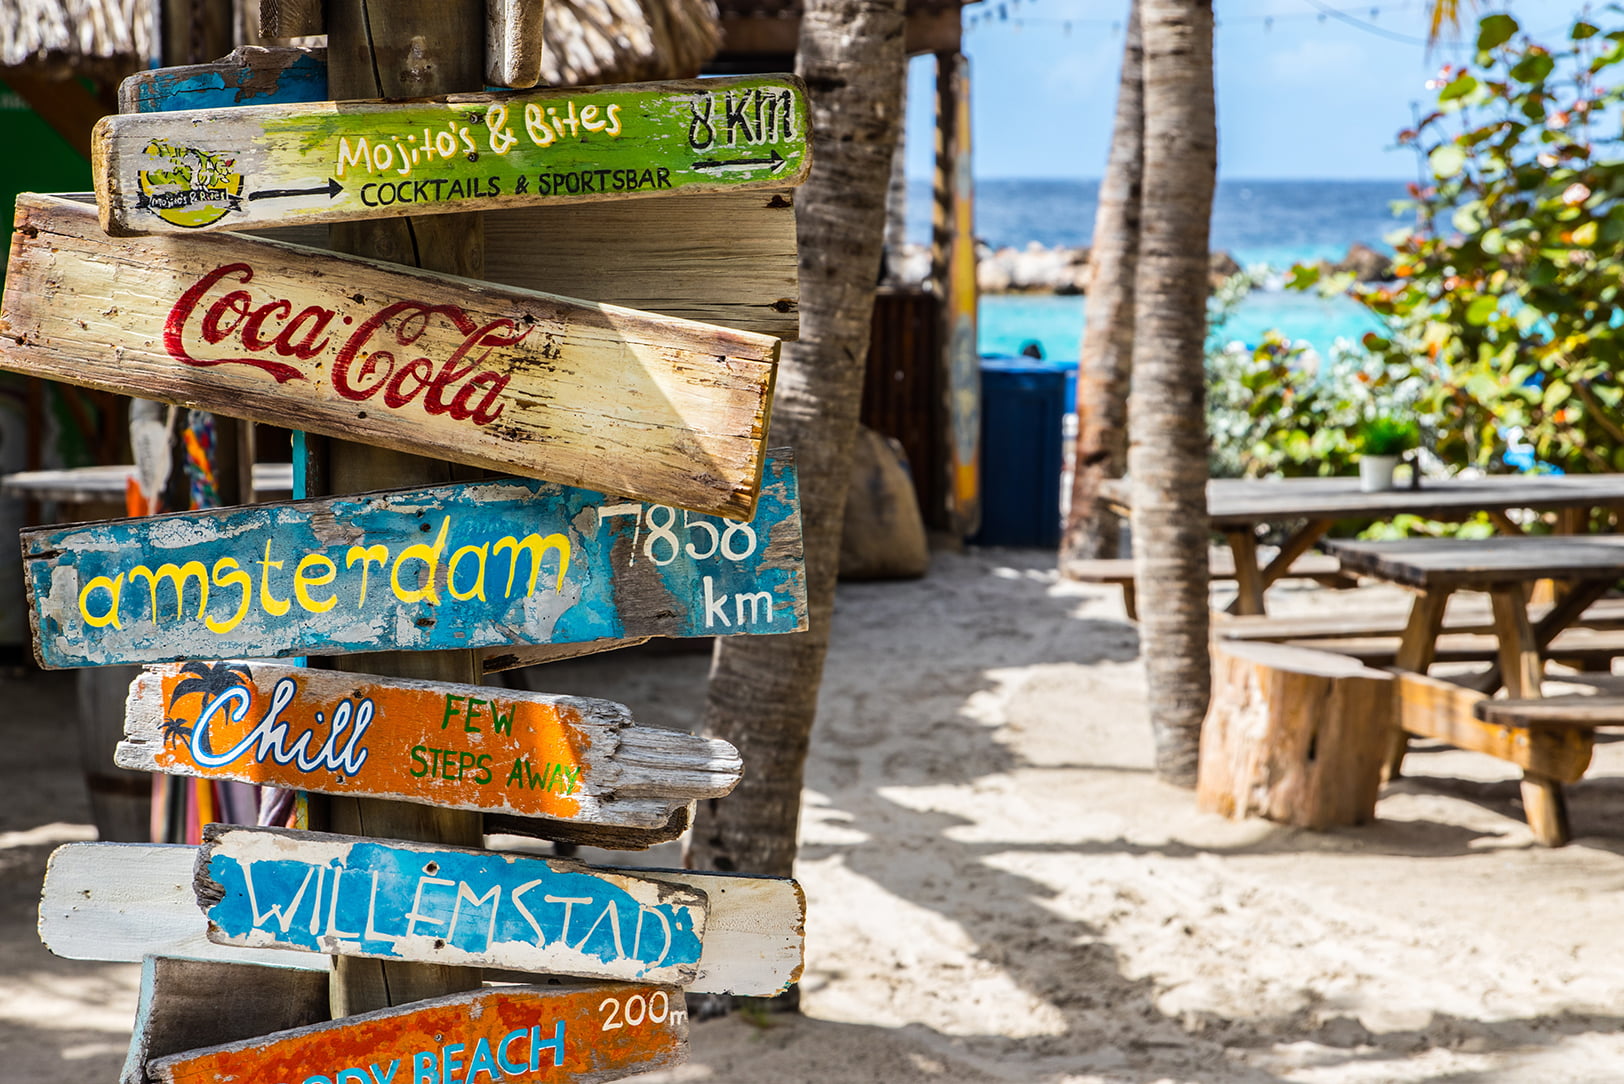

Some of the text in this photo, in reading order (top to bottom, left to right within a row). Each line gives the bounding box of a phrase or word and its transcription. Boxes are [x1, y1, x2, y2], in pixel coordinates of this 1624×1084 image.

[336, 101, 622, 177] Mojito's & Bites
[360, 167, 673, 206] COCKTAILS & SPORTSBAR
[598, 503, 757, 566] 7858
[79, 515, 572, 634] amsterdam
[703, 576, 773, 627] km
[190, 676, 375, 777] Chill
[441, 694, 515, 737] FEW
[410, 745, 581, 795] STEPS AWAY
[242, 864, 672, 971] WILLEMSTAD
[413, 1019, 567, 1084] BEACH
